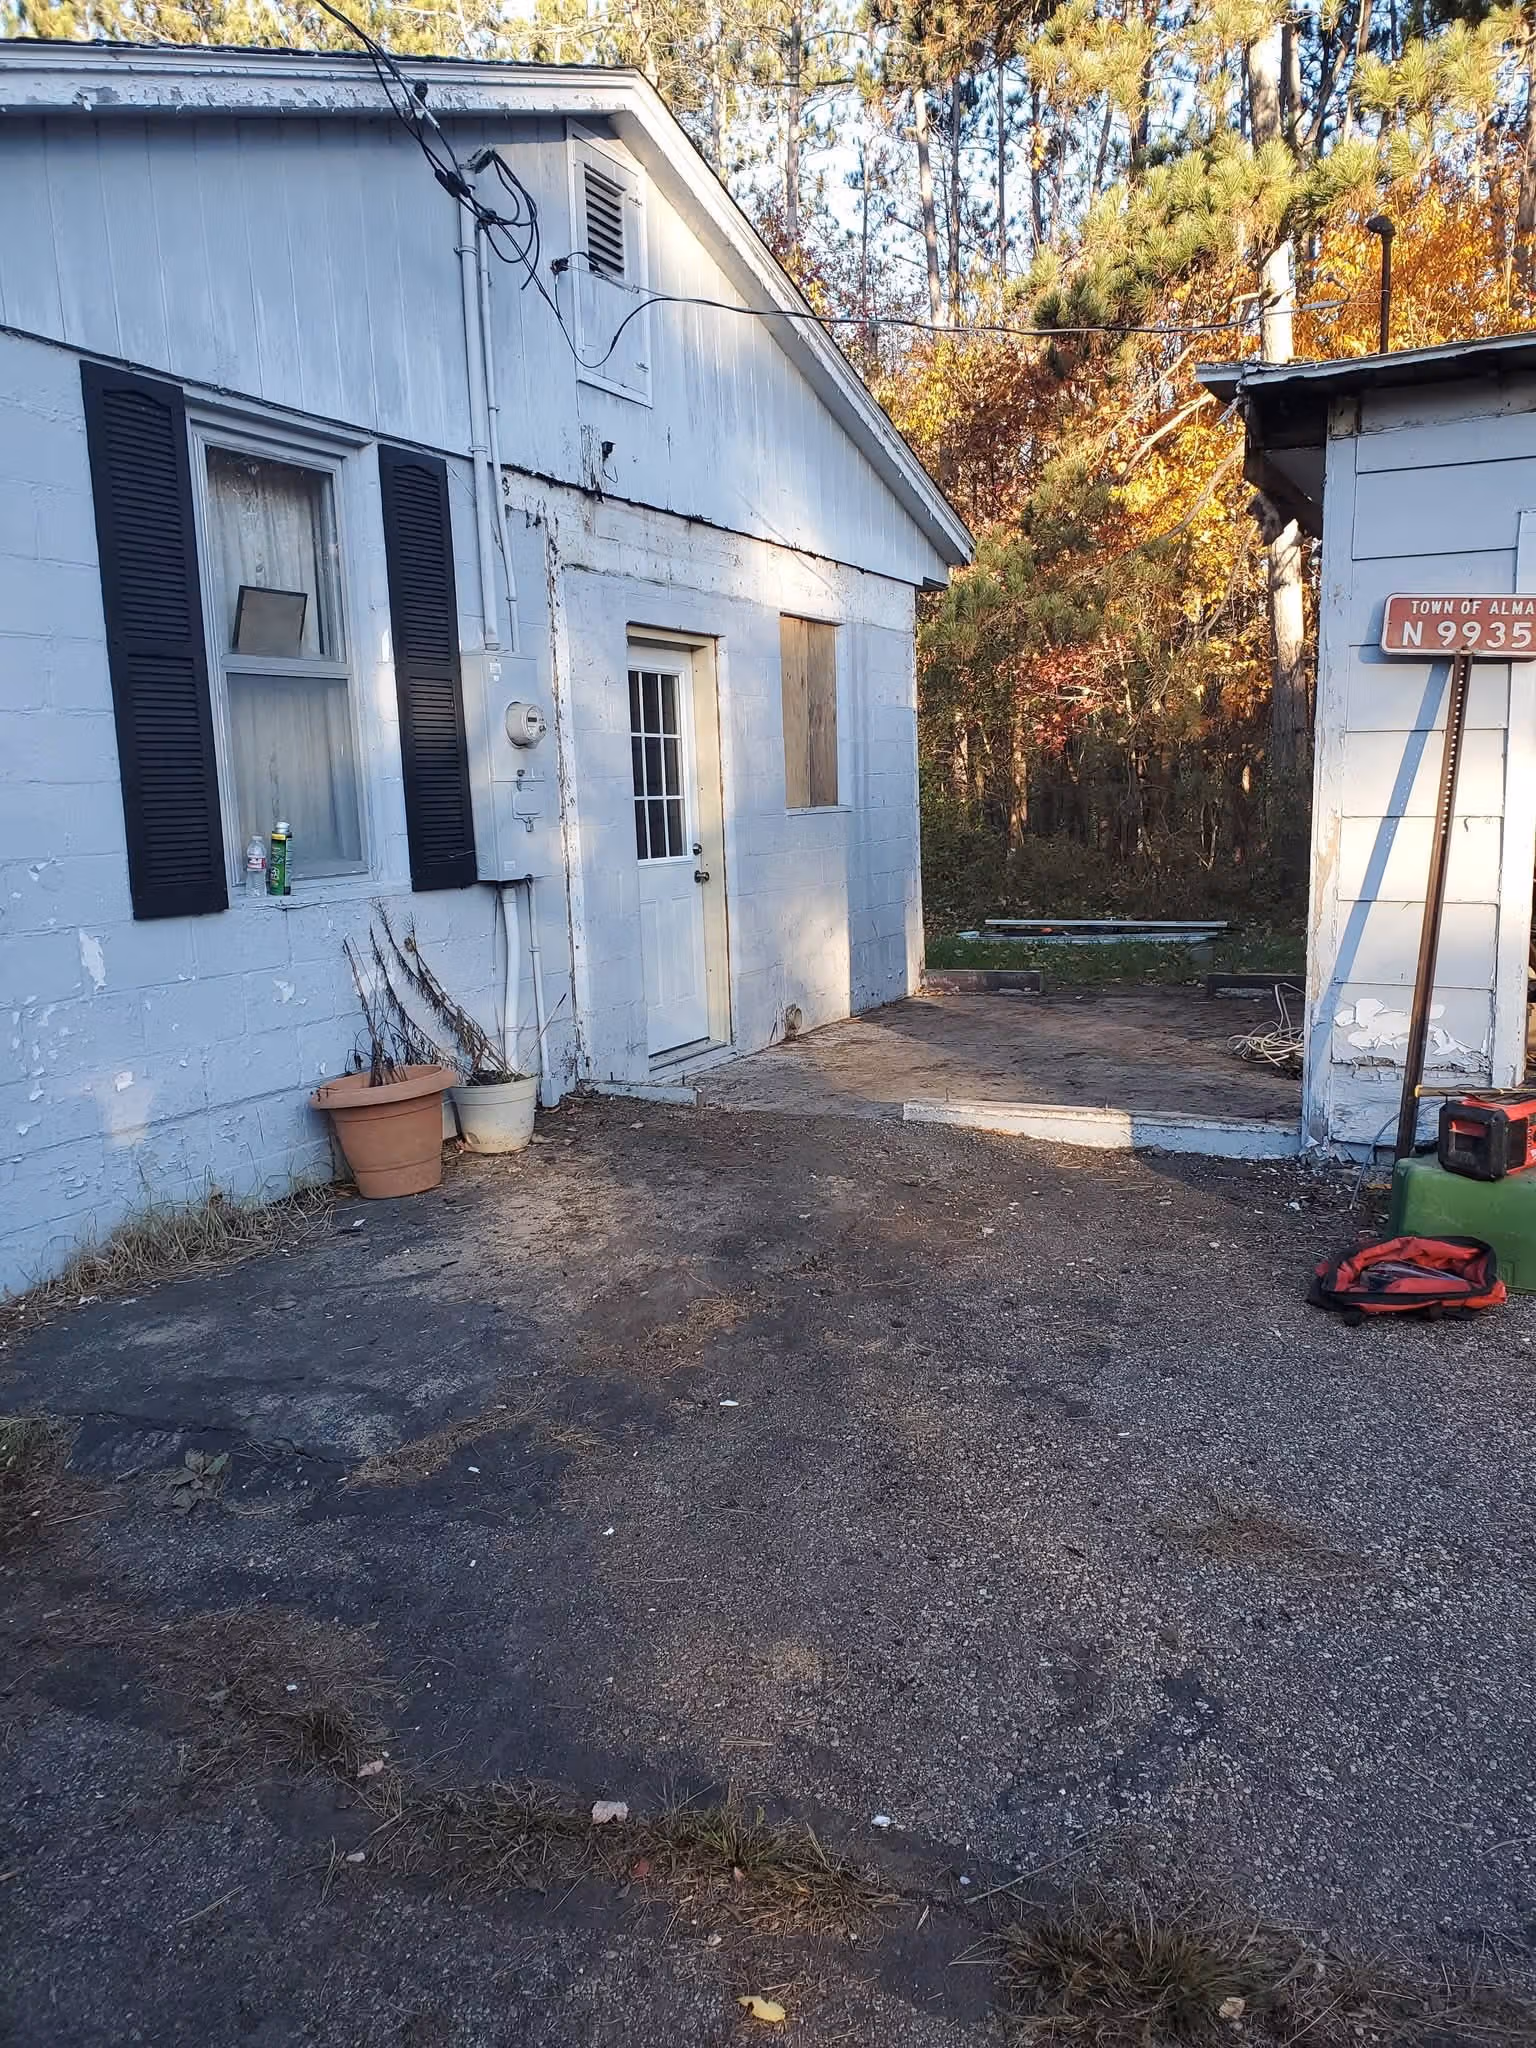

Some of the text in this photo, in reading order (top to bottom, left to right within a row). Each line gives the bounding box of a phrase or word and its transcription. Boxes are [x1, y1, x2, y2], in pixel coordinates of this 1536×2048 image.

[1411, 600, 1535, 615] TOWN OF ALMA
[1402, 621, 1533, 648] N 9935
